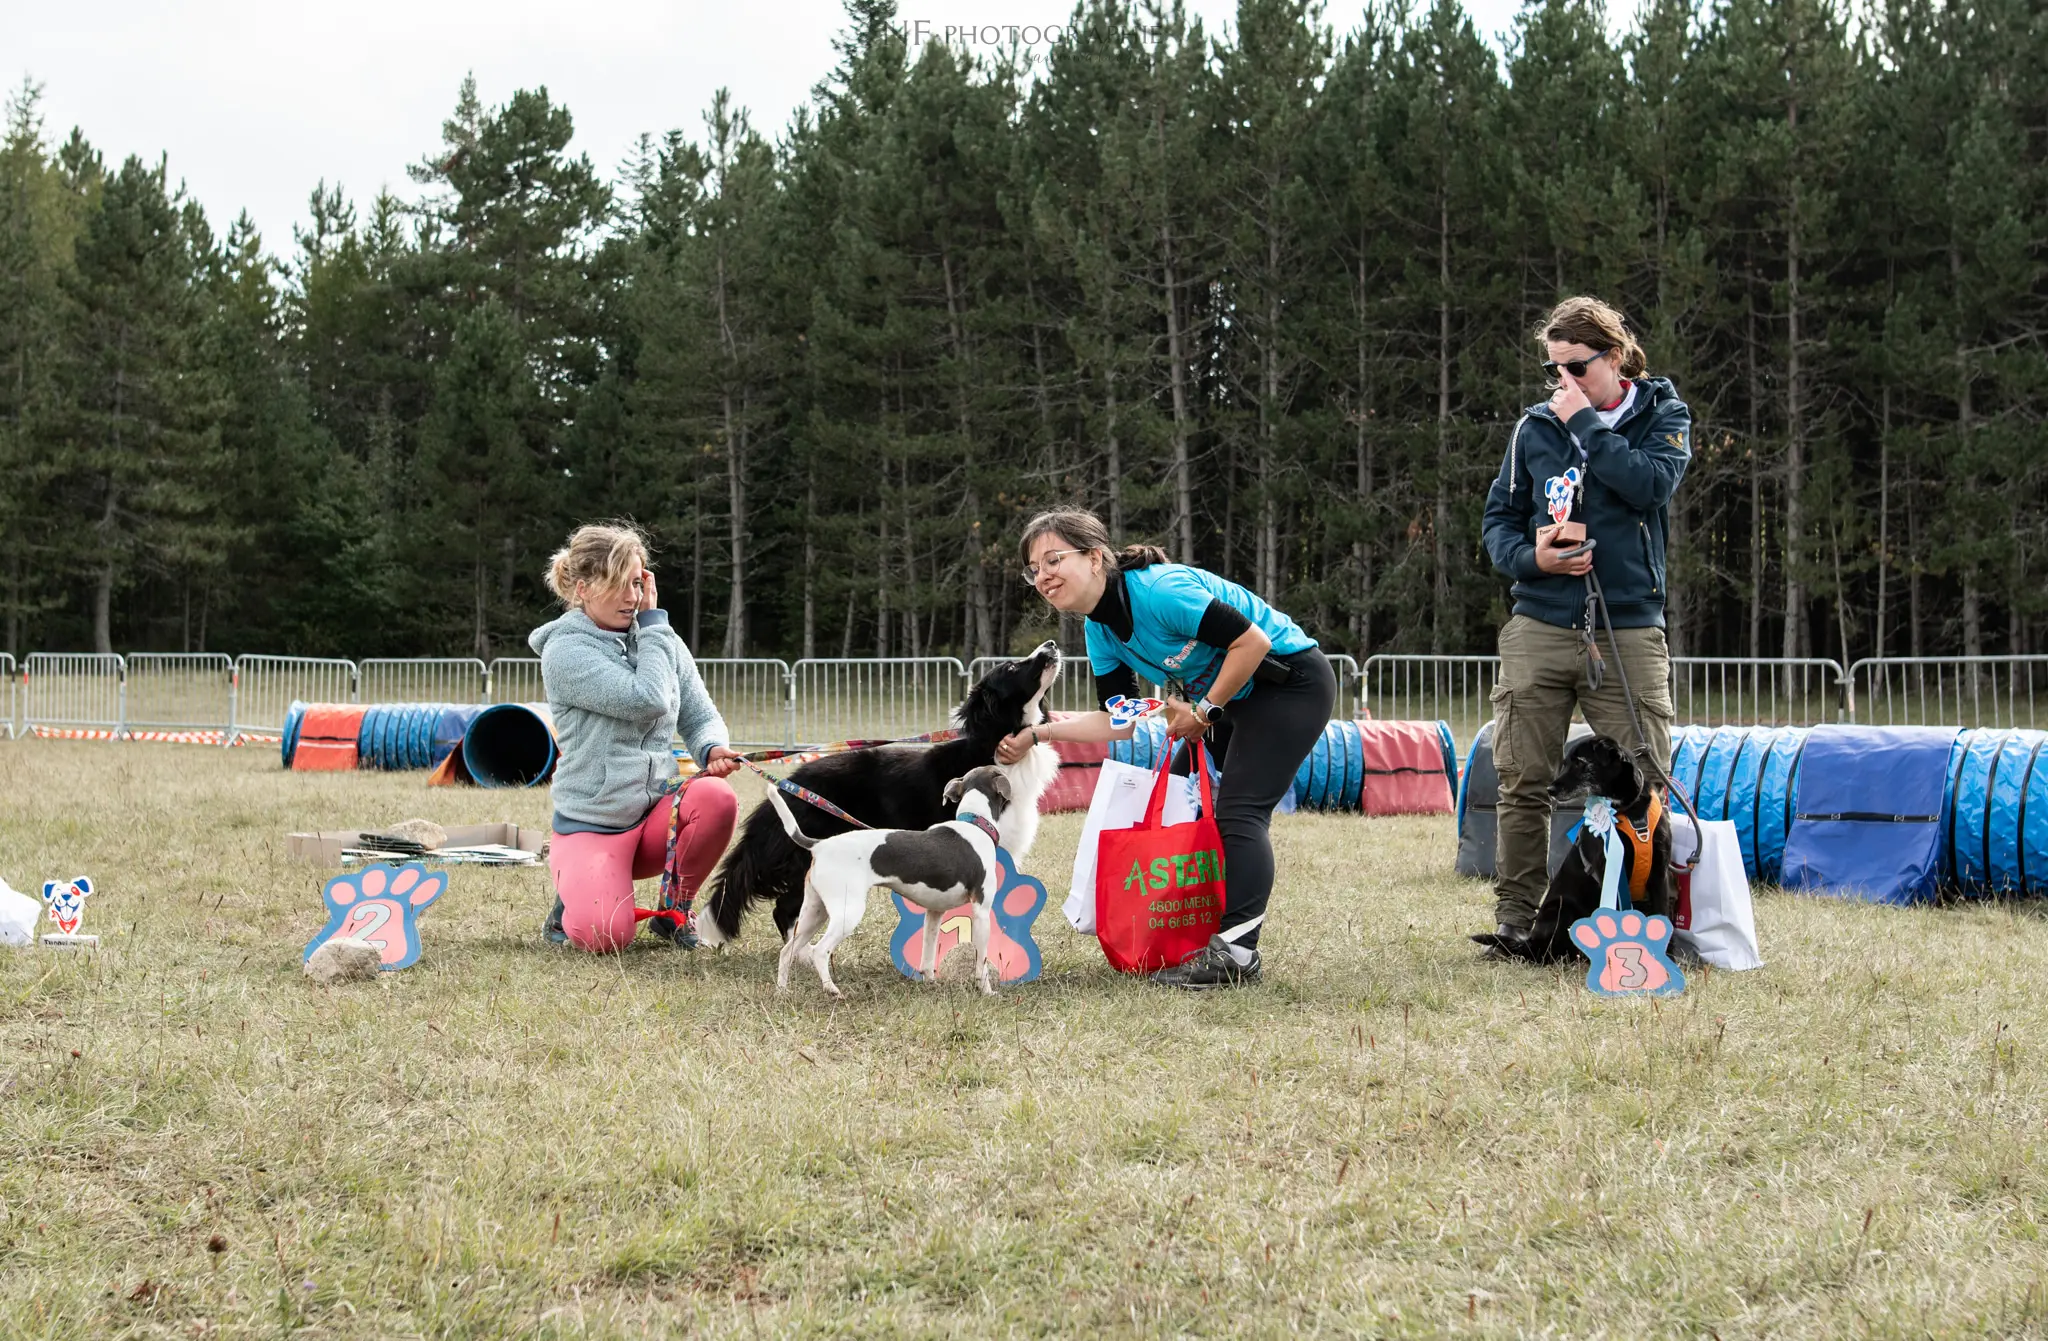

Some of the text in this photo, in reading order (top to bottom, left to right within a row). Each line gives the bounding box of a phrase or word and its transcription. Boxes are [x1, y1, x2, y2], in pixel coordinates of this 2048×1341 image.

[1123, 849, 1227, 897] ASTERI
[352, 903, 391, 950] 2
[939, 915, 973, 944] 1
[1148, 917, 1165, 929] 04
[1182, 914, 1197, 926] 65
[1200, 911, 1213, 924] 12
[1614, 947, 1649, 988] 3
